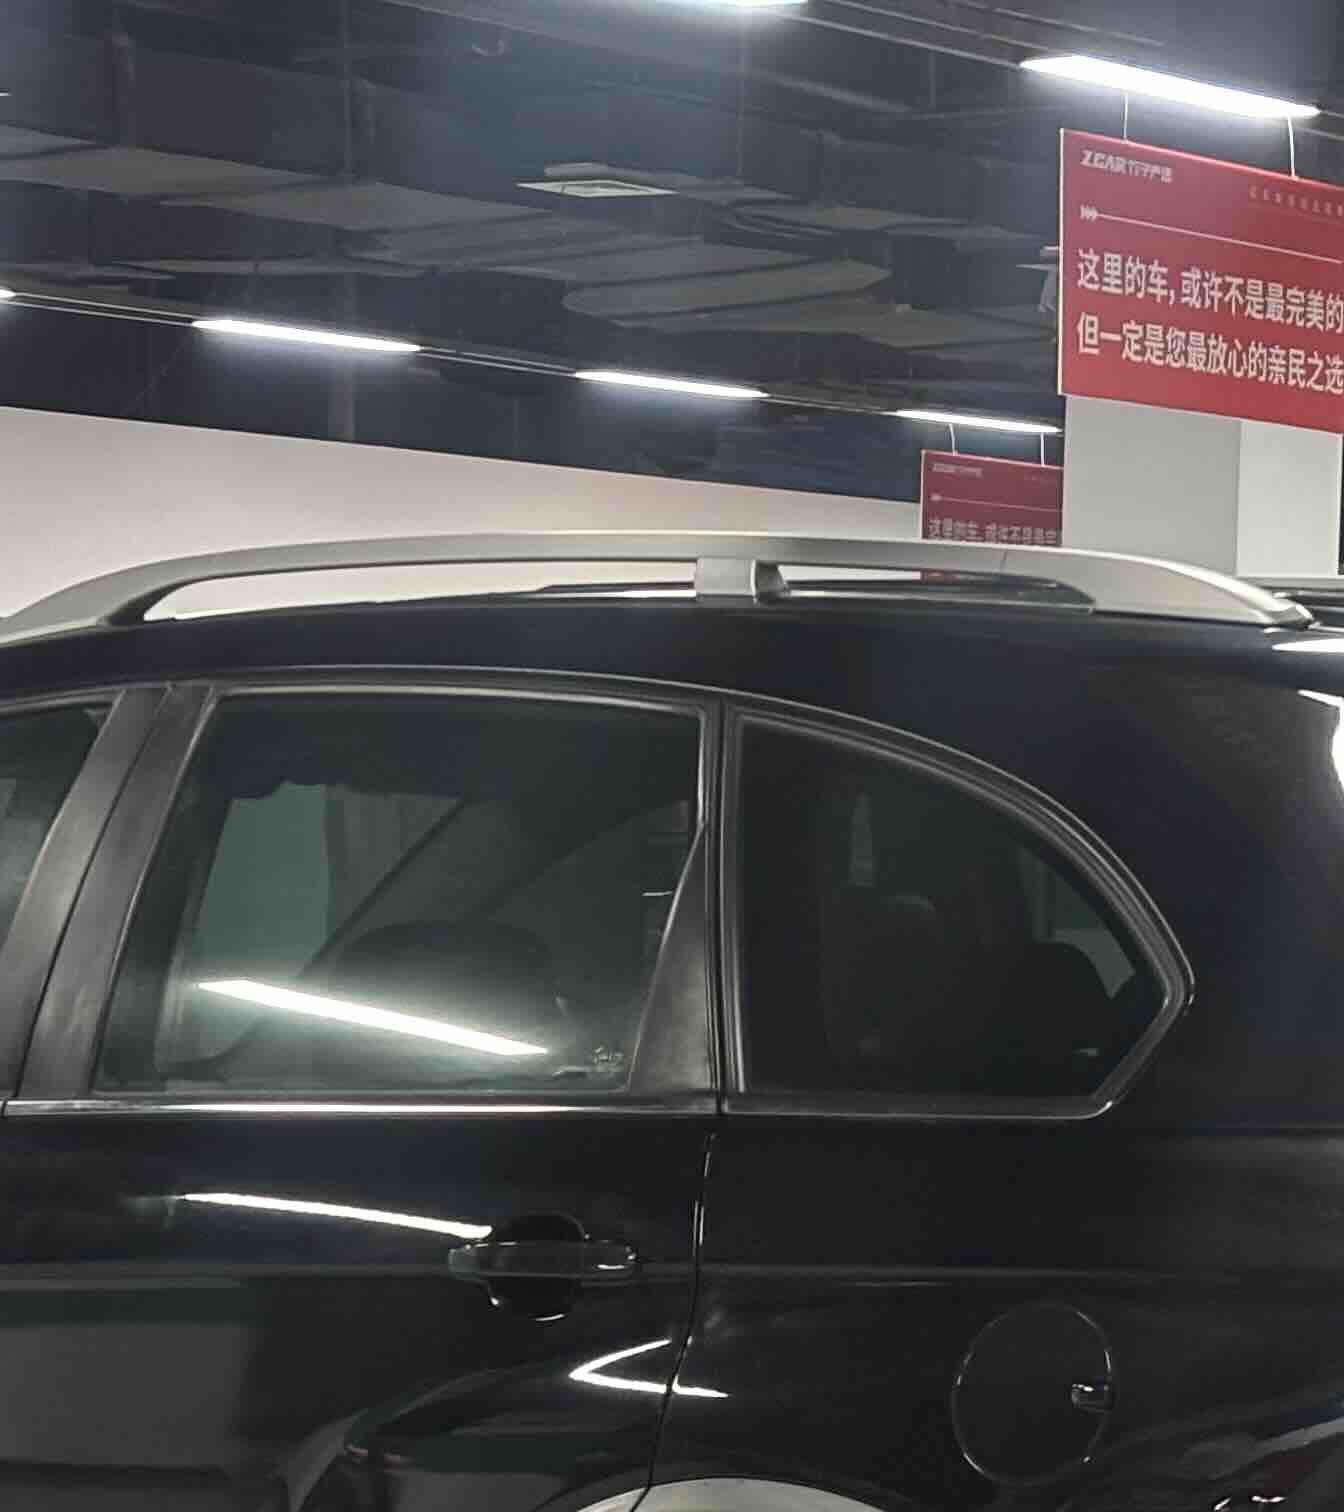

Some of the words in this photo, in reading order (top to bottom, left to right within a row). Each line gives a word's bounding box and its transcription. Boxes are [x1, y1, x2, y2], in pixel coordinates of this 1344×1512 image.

[1076, 311, 1344, 395] 但一定是您最放心的亲民之选
